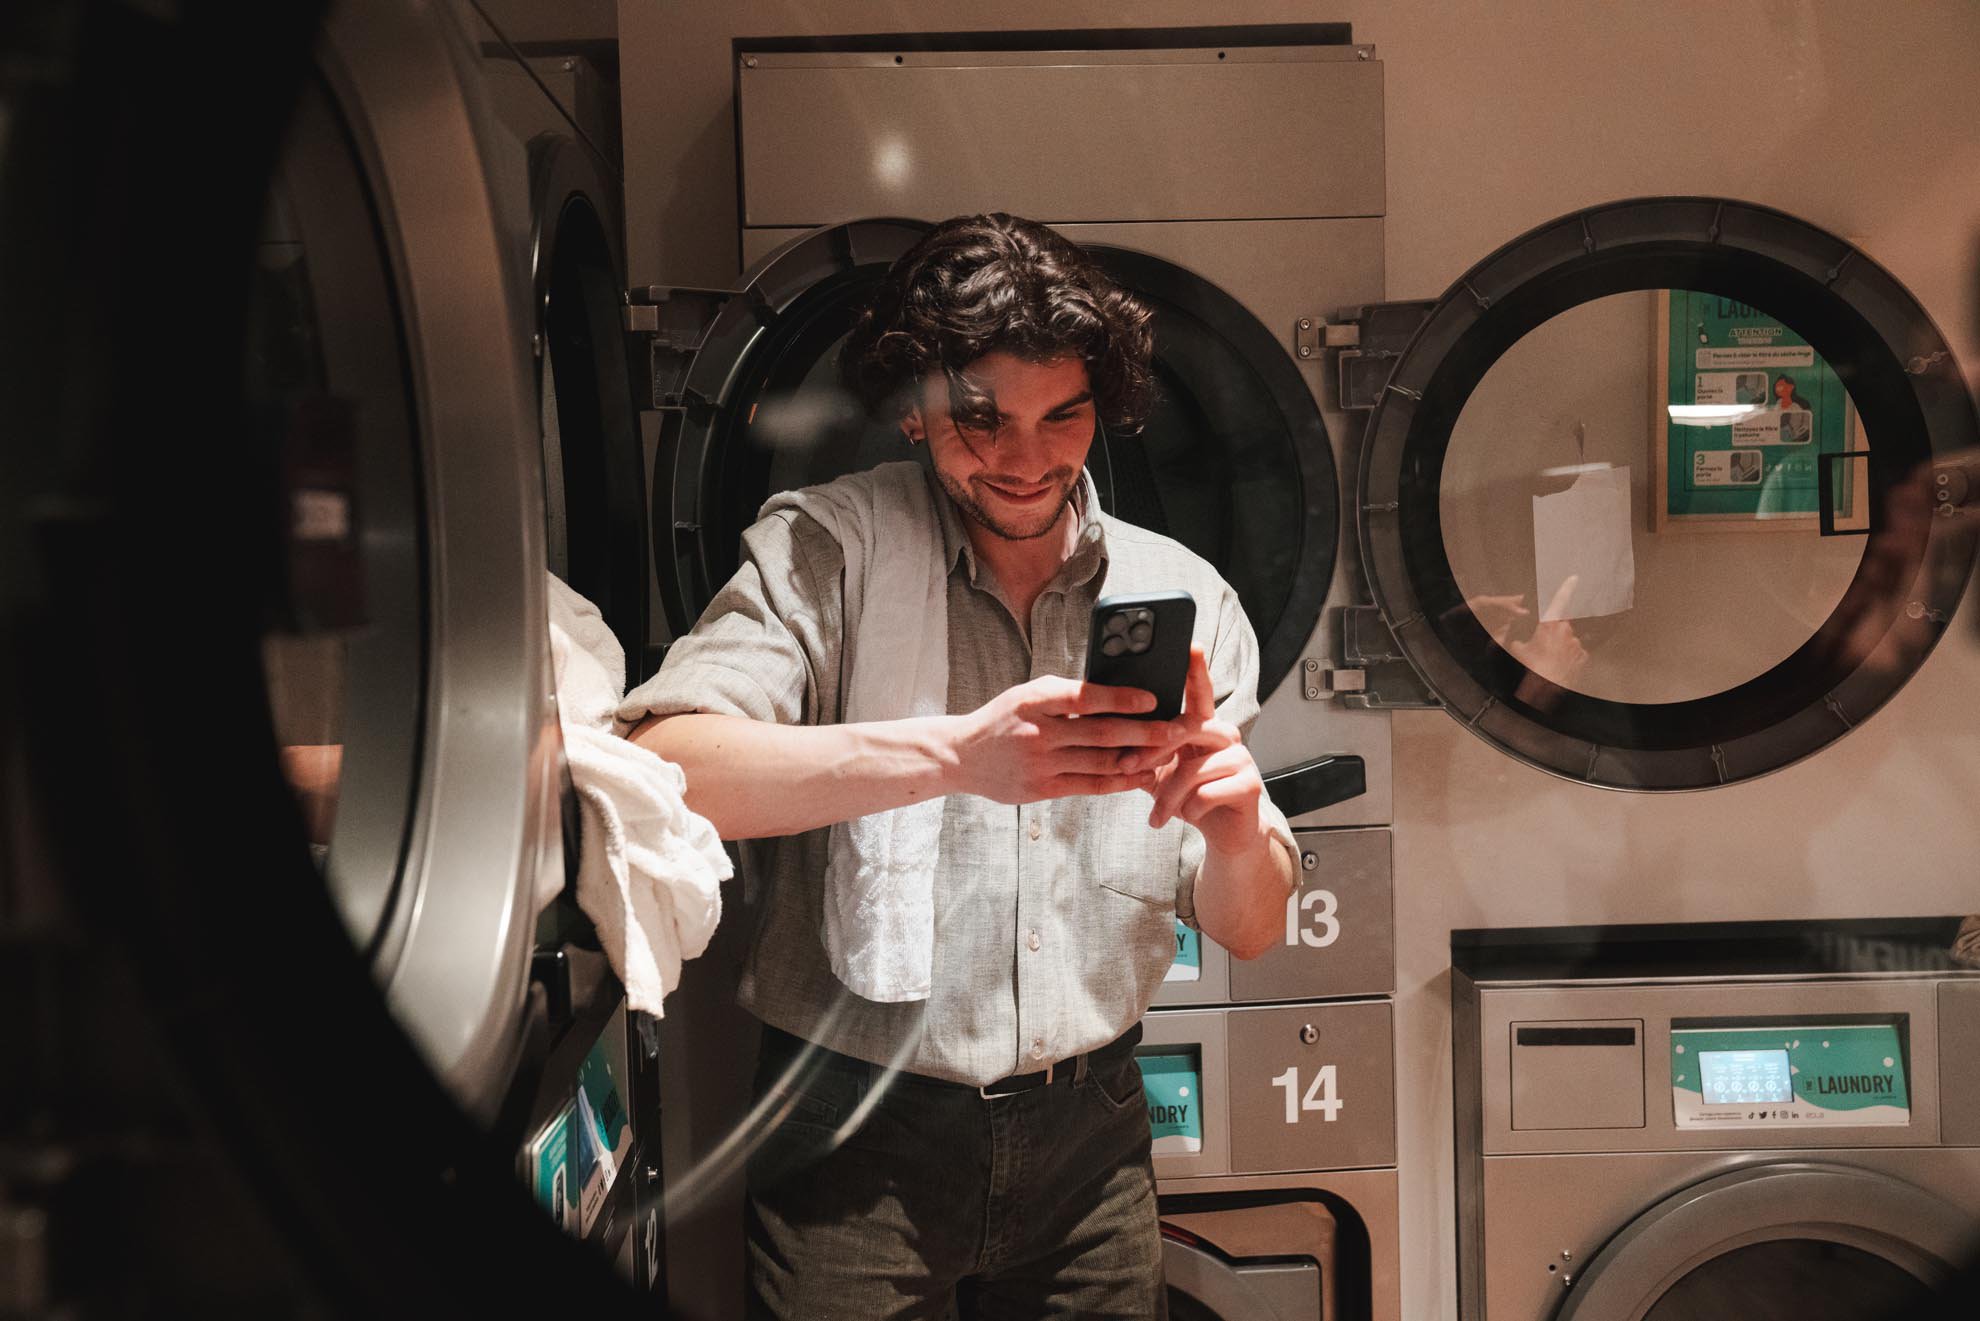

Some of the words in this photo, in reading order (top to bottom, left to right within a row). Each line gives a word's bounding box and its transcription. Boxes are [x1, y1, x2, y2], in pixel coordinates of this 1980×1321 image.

[1729, 328, 1782, 337] ATTENTION
[1697, 376, 1703, 387] 1
[1696, 454, 1705, 465] 3
[1286, 889, 1340, 947] 13
[1818, 1075, 1893, 1095] LAUNDRY
[1272, 1065, 1343, 1124] 14
